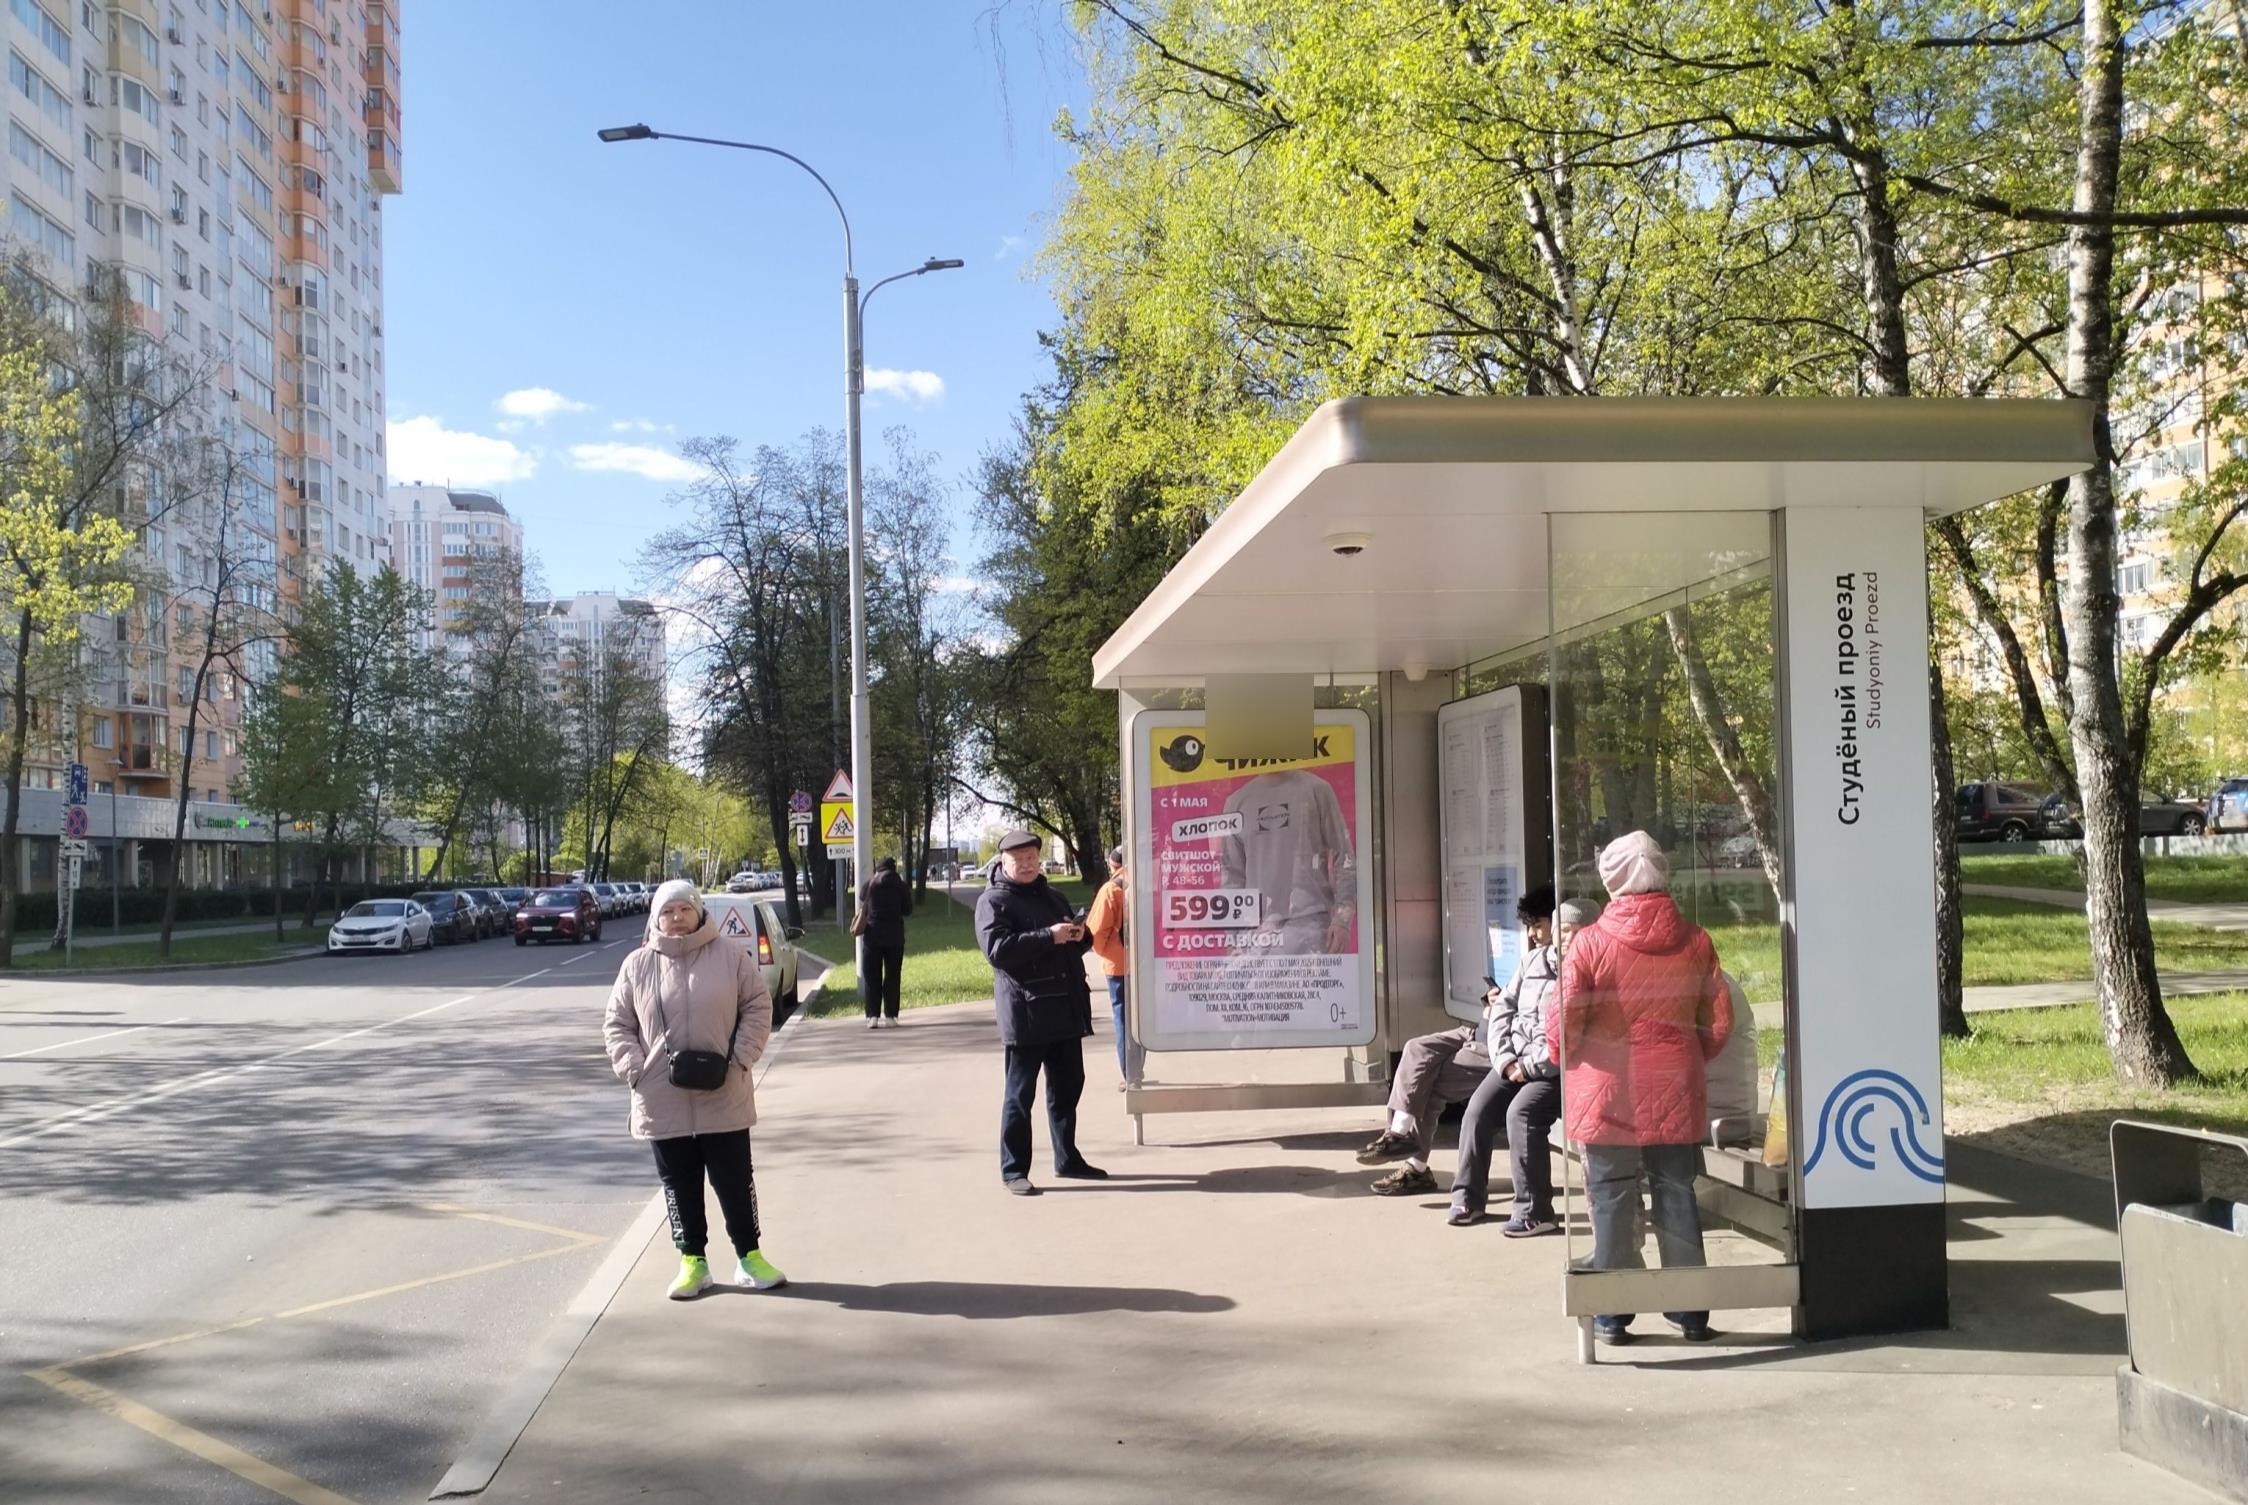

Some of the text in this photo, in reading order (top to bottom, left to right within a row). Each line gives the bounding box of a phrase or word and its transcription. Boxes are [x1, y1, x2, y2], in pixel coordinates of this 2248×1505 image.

[1862, 571, 1884, 729] Studyoniy Proezd
[1835, 573, 1864, 825] Студёный проезд
[1160, 798, 1168, 808] С
[1179, 798, 1208, 808] МАЯ
[1179, 817, 1238, 838] ХЛОПОК
[1161, 851, 1217, 860] СВИТШОТ
[1161, 861, 1221, 873] МУЖСКОЙ
[1172, 876, 1205, 886] 48-56
[1170, 895, 1230, 921] 599
[1233, 895, 1254, 907] 00
[1162, 931, 1284, 951] С ДОСТАВКОЙ
[1330, 1002, 1346, 1023] 0+
